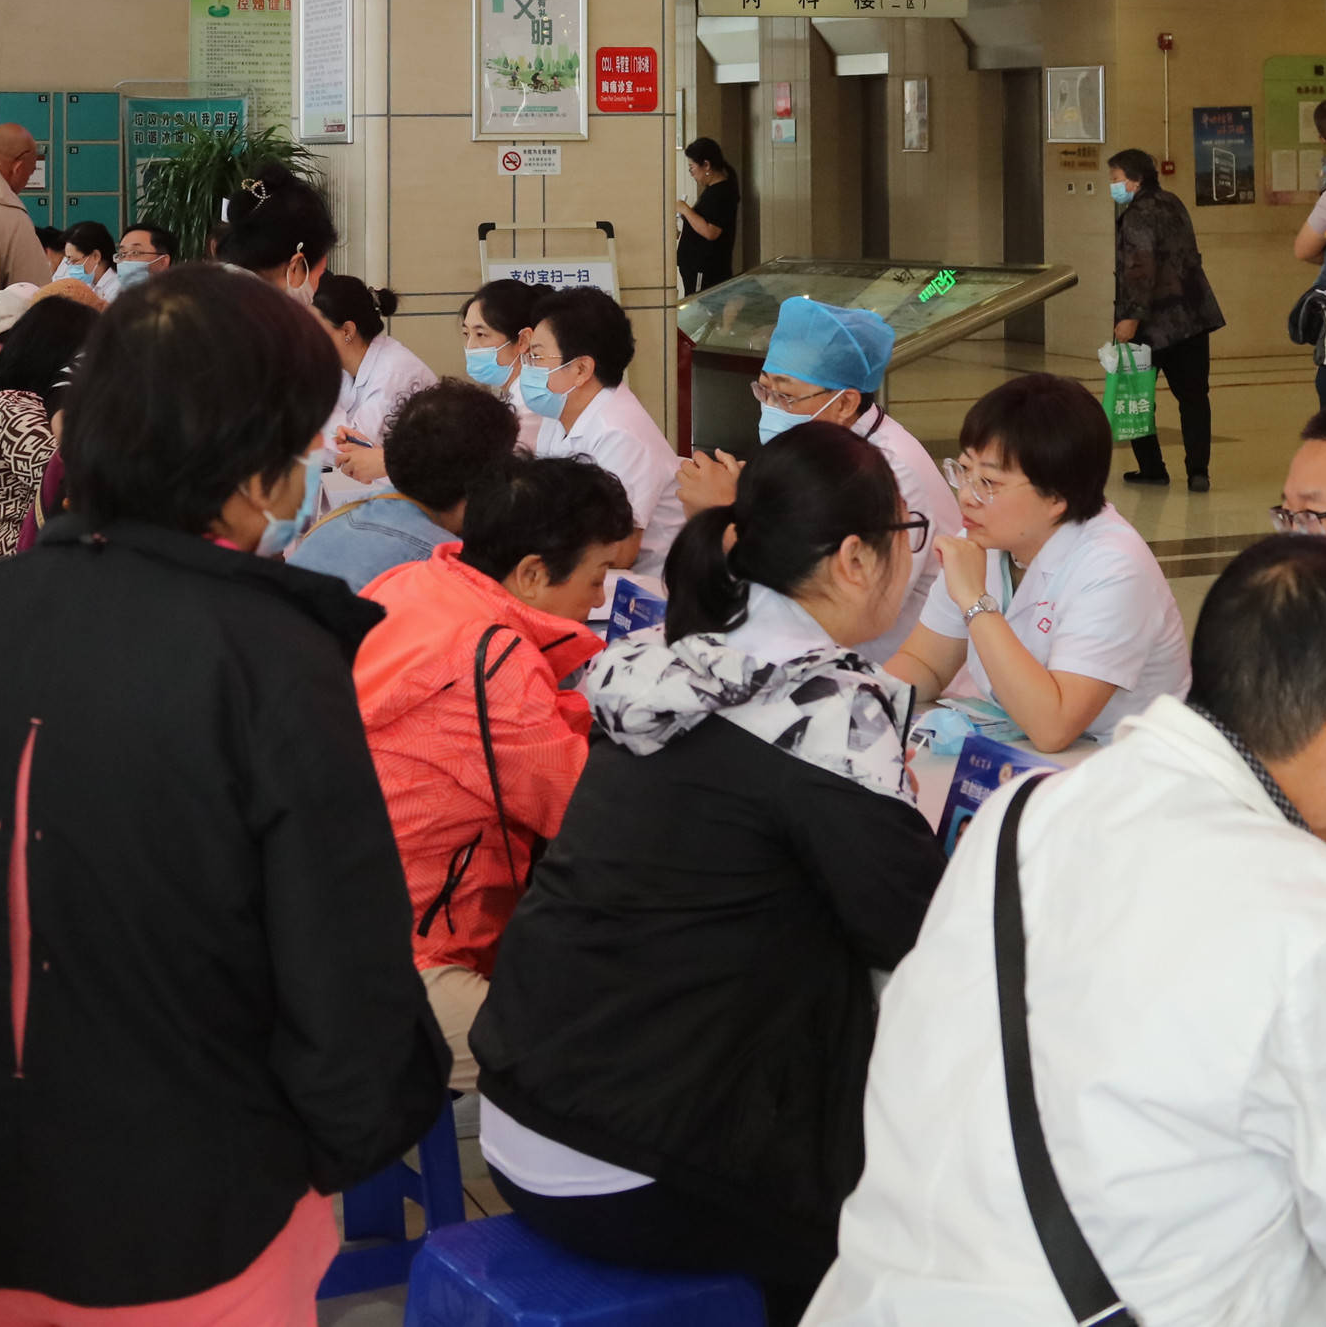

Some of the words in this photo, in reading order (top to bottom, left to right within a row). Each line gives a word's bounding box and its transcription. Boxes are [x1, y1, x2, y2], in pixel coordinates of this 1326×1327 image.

[509, 269, 590, 283] 支付宝扫一扫
